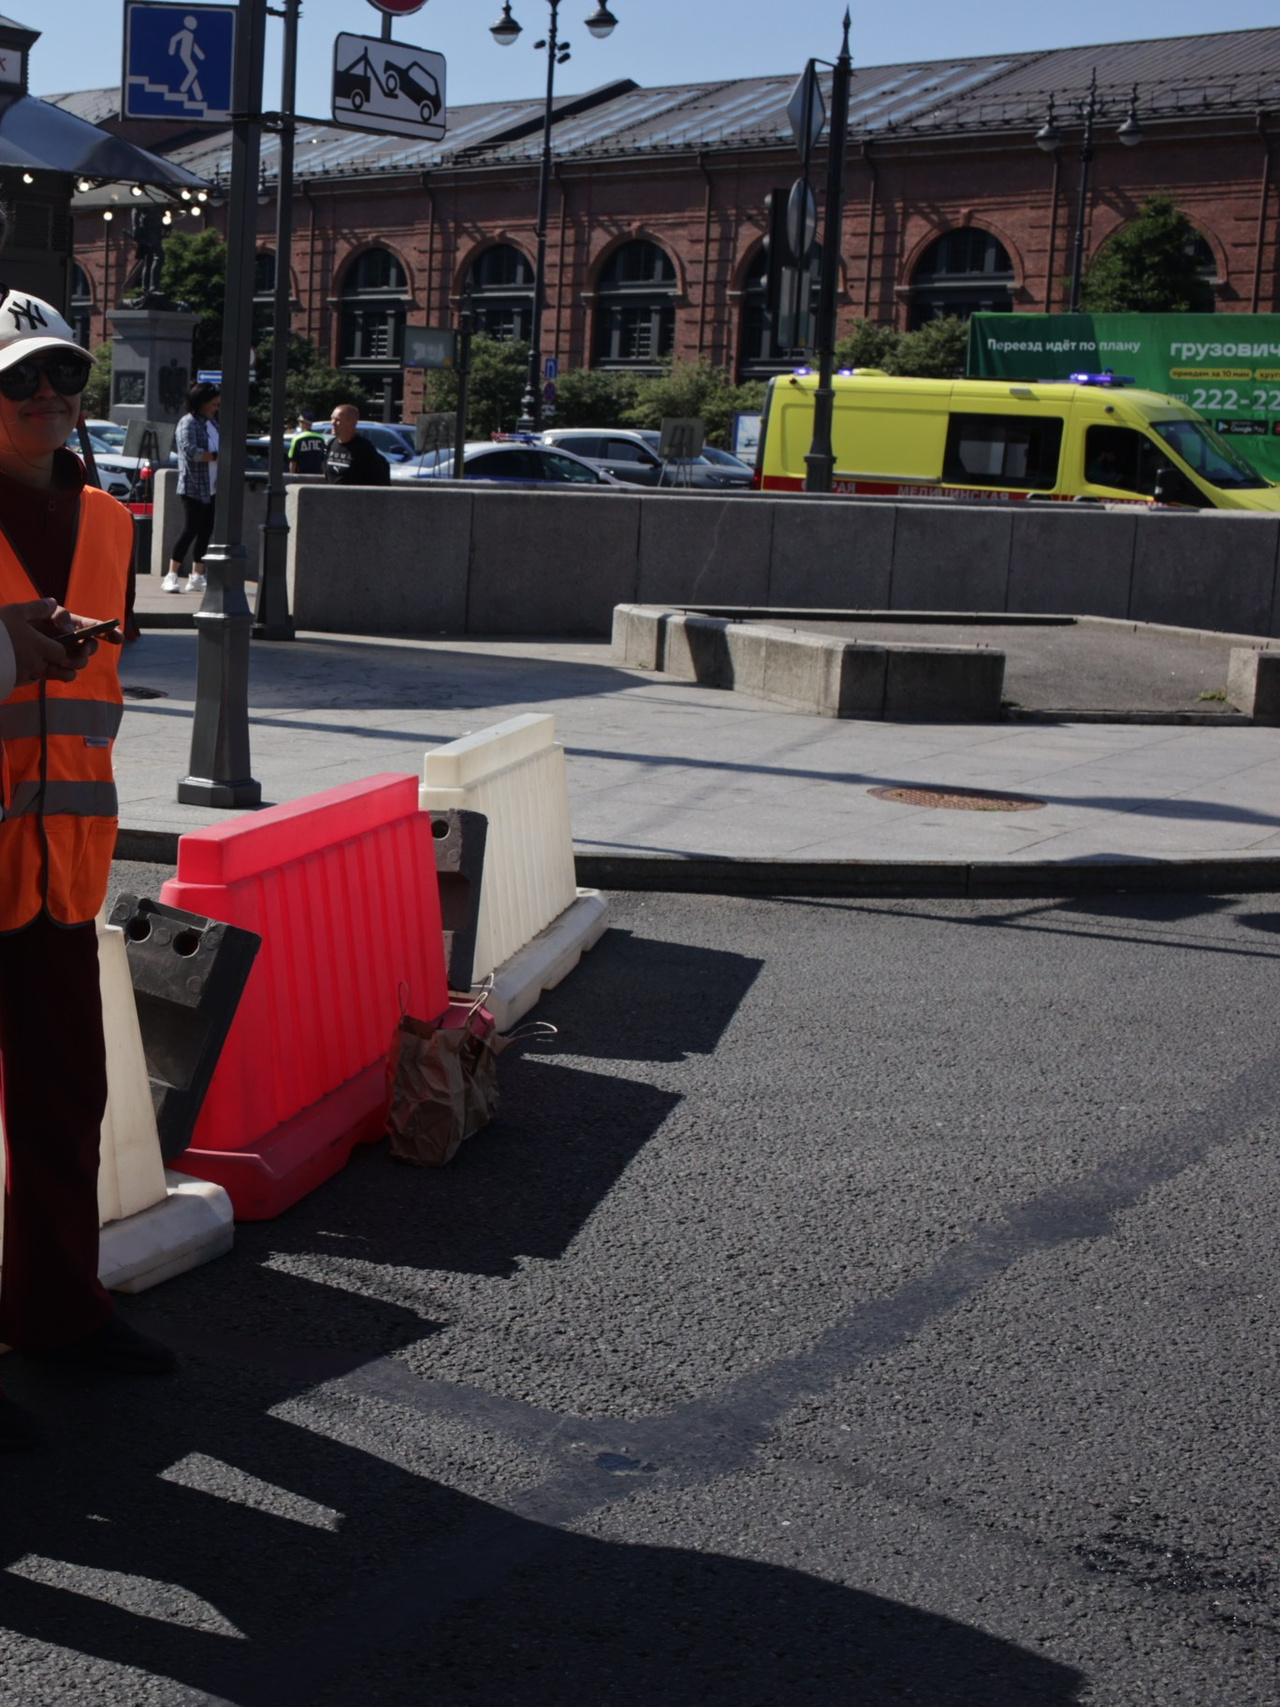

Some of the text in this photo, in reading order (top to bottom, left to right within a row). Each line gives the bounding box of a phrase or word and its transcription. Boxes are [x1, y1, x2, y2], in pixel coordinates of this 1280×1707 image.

[7, 300, 48, 331] NY
[988, 338, 1141, 353] Переезд идёт по плану
[1222, 370, 1232, 378] 10
[1230, 424, 1252, 436] Google
[301, 440, 322, 452] ДПС
